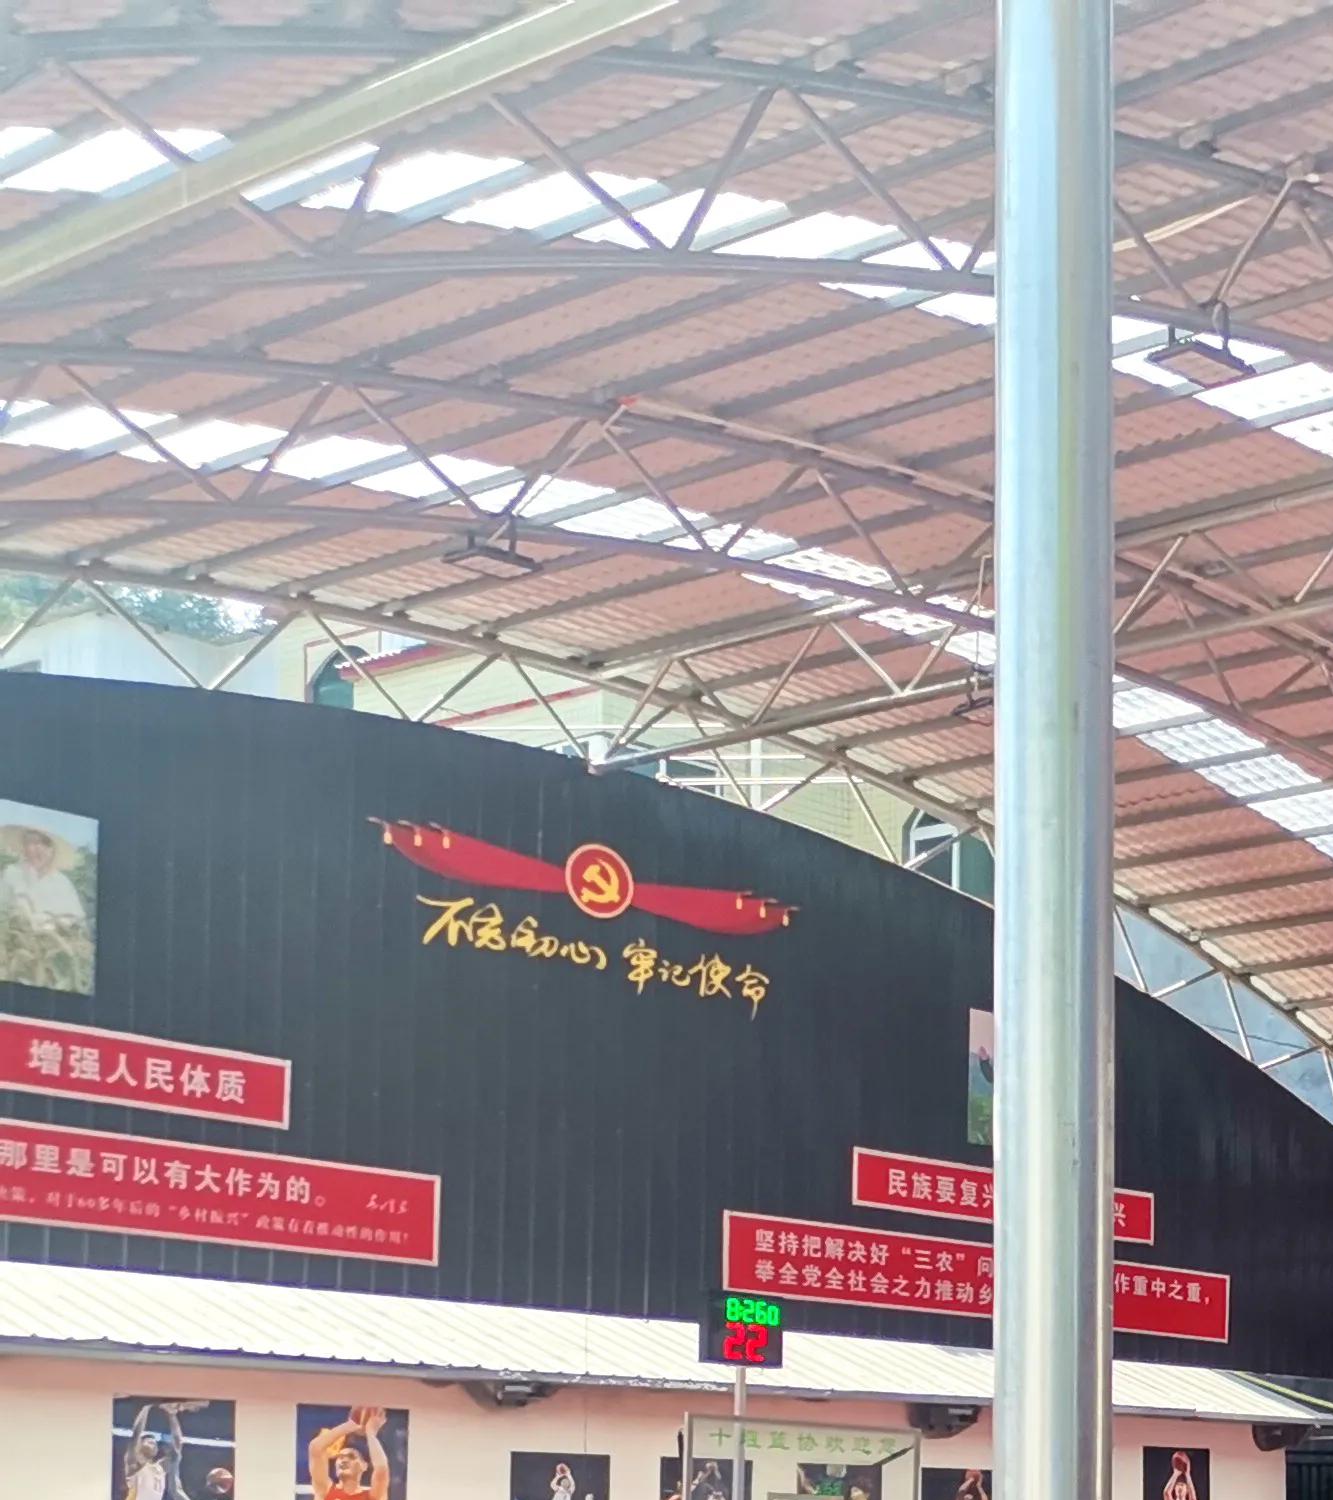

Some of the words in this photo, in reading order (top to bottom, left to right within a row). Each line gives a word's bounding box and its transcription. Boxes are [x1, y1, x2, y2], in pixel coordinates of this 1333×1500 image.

[27, 1037, 246, 1105] 增强人民体质
[723, 1322, 768, 1361] 22
